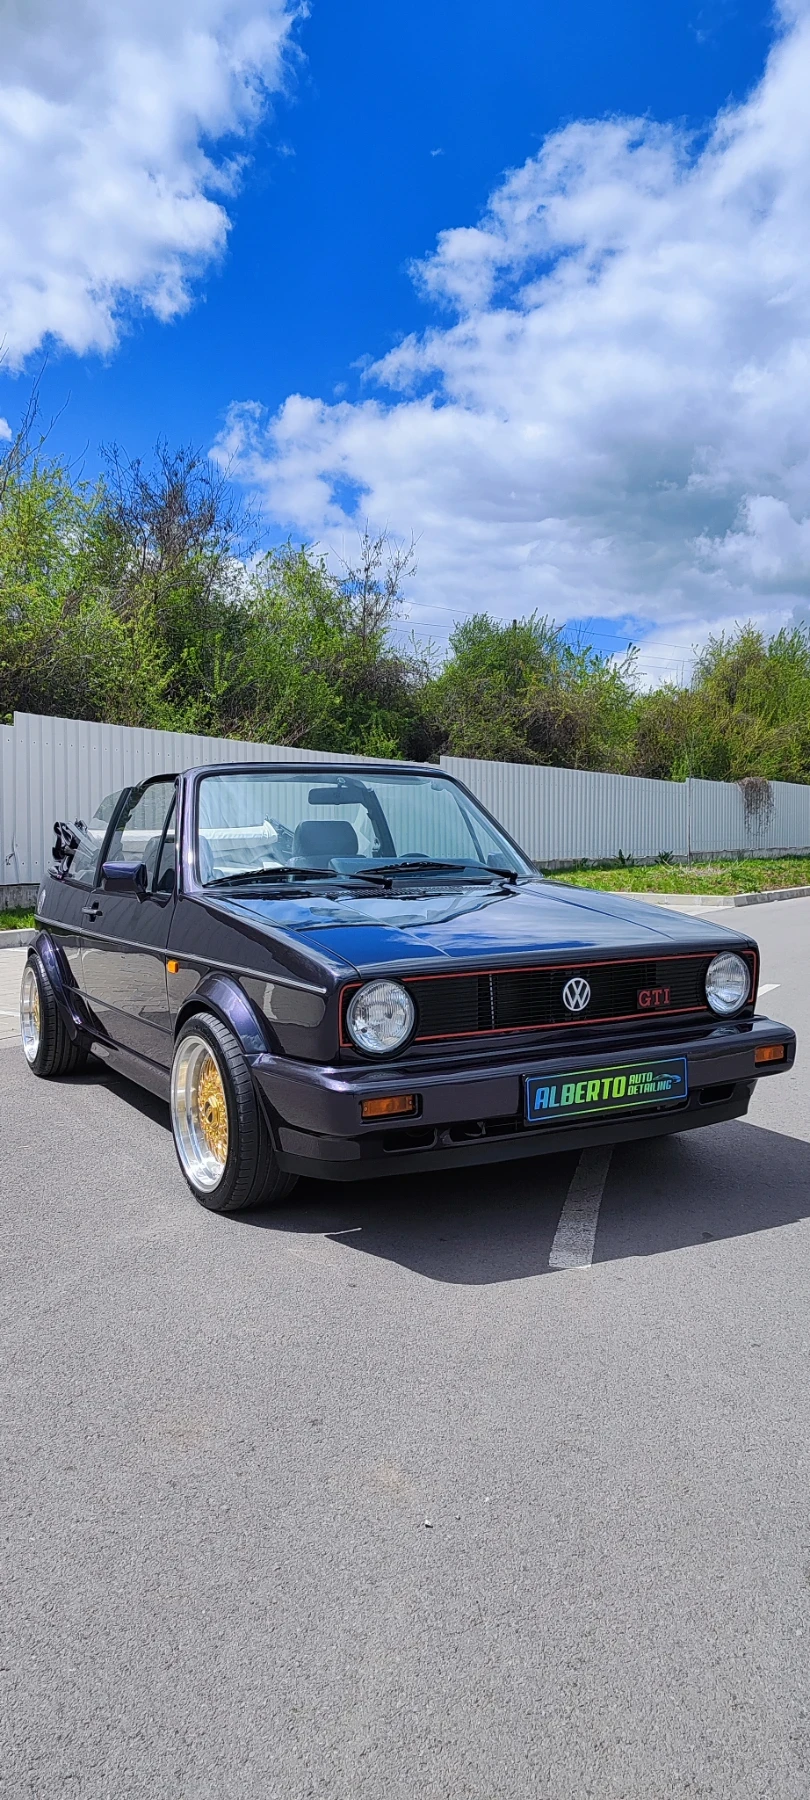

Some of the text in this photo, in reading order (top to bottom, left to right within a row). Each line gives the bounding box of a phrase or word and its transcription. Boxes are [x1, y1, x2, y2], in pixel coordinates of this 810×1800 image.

[638, 988, 671, 1008] GTI
[629, 1072, 653, 1084] AUTO
[534, 1075, 626, 1110] ALBERTO
[627, 1080, 672, 1096] DETAILING
